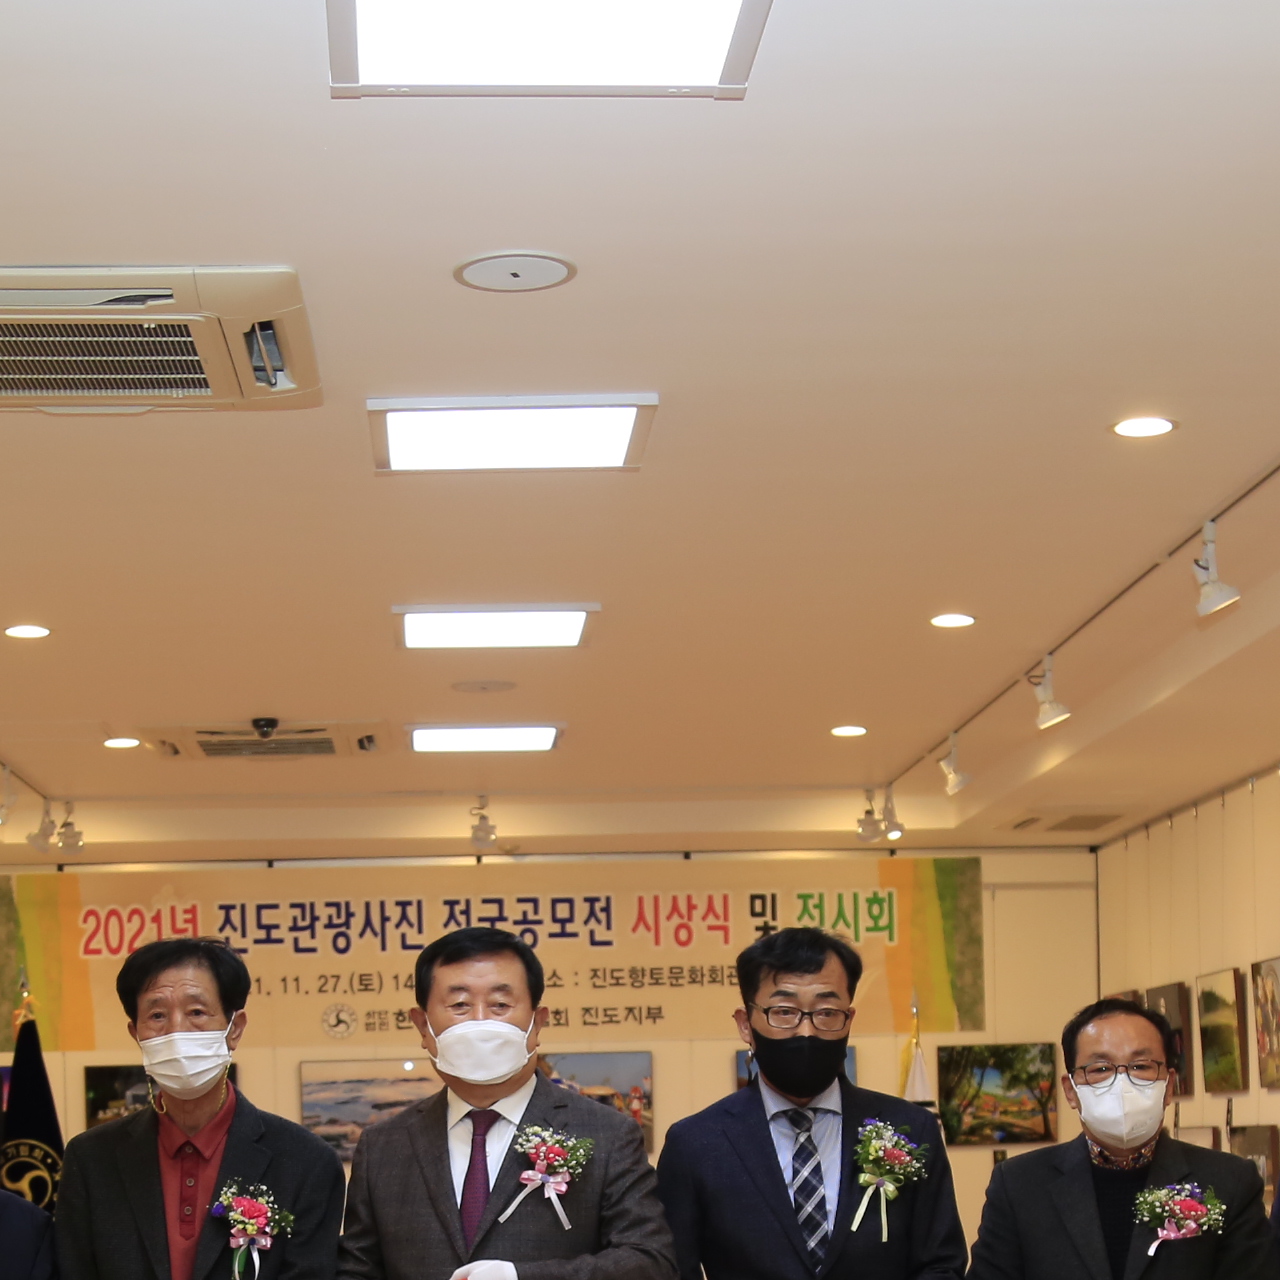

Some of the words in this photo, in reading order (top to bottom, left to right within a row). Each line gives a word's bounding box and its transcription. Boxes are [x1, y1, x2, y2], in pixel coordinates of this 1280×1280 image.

[218, 899, 425, 954] 진도관광사진
[631, 893, 730, 947] 시상식
[581, 1005, 665, 1027] 진도지부
